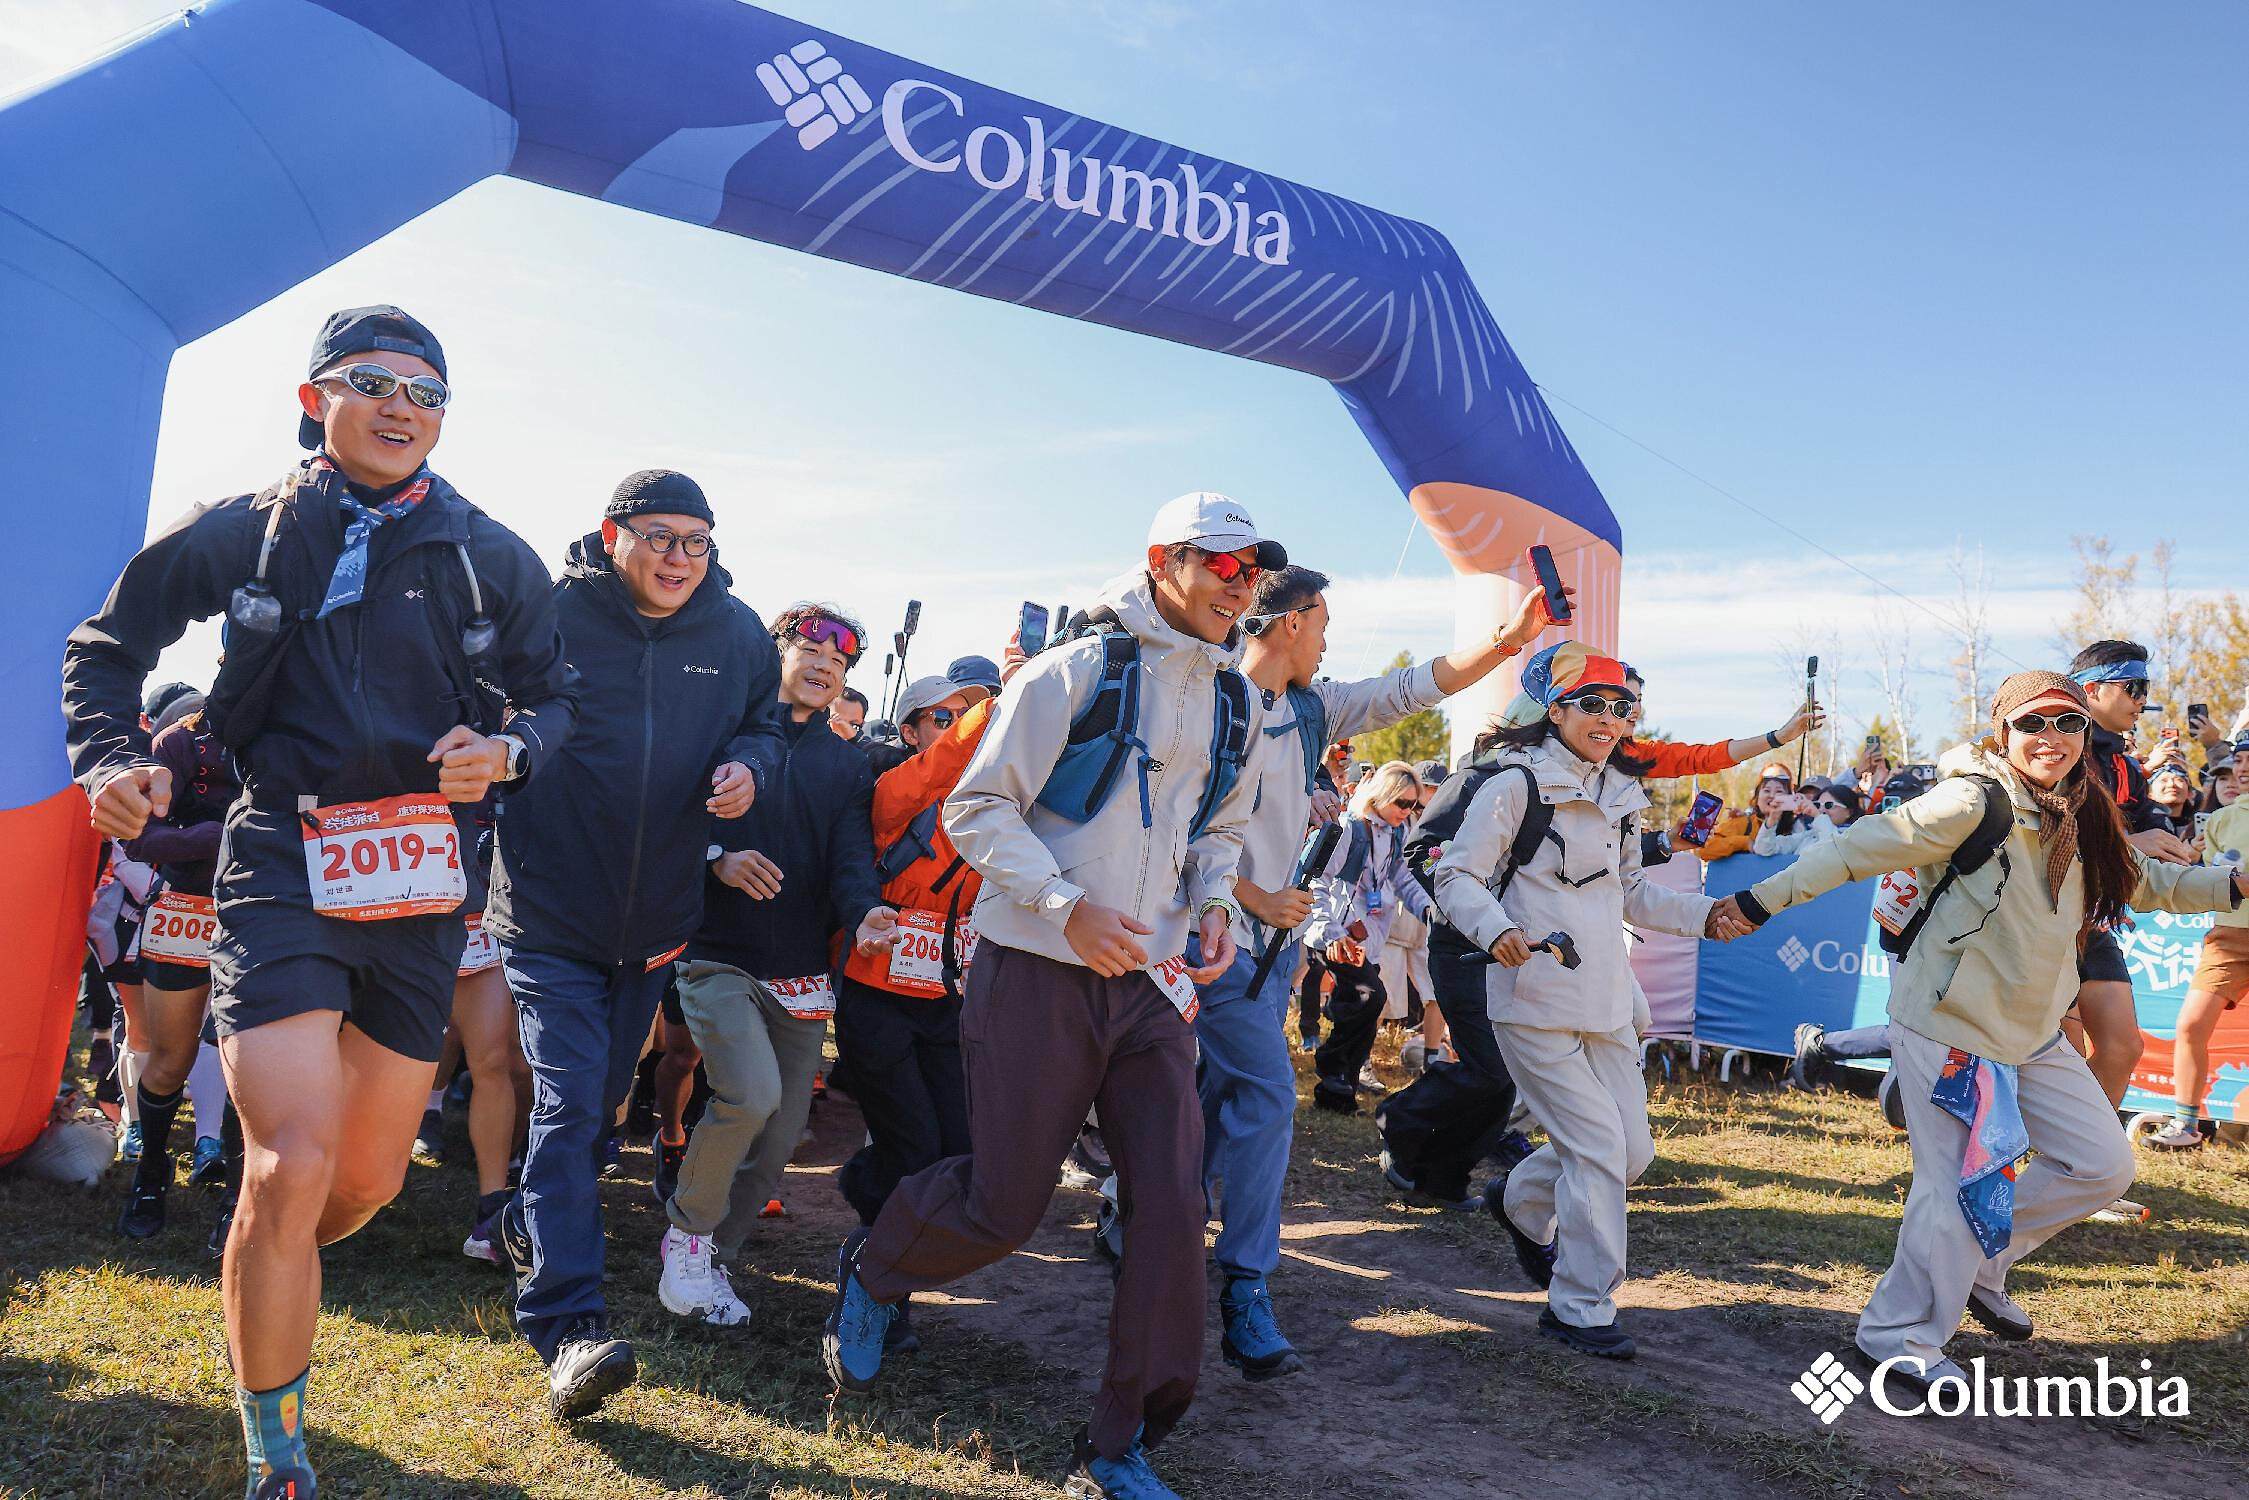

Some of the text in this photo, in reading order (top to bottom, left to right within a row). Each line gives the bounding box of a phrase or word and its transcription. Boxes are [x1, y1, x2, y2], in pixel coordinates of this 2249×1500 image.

[882, 79, 1290, 266] Columbia
[690, 665, 719, 675] Columbia
[321, 832, 459, 882] 2019-2
[150, 913, 217, 942] 2008
